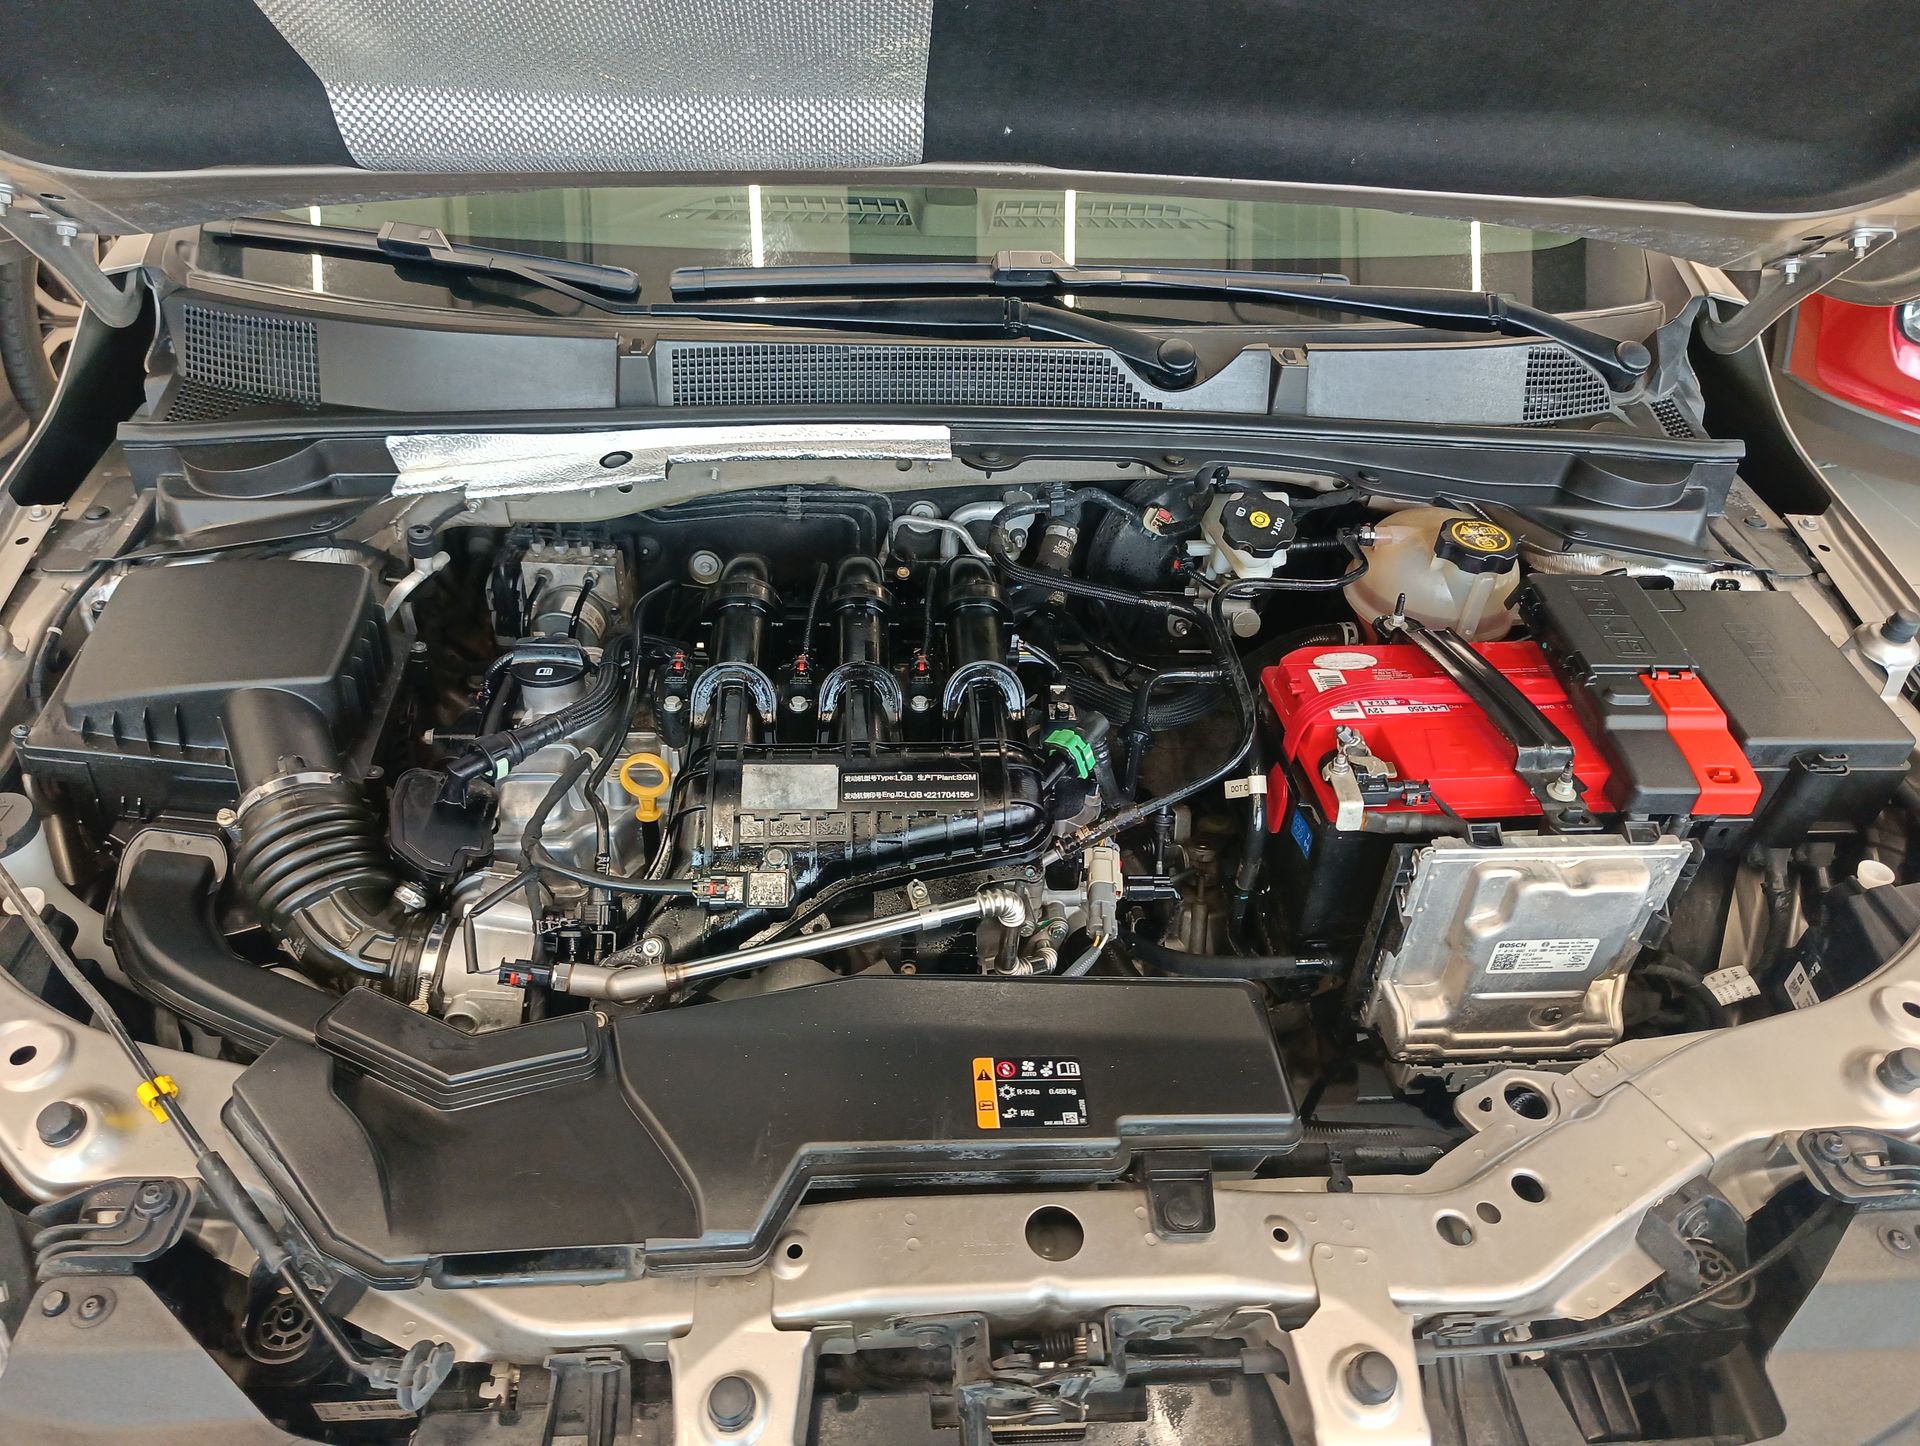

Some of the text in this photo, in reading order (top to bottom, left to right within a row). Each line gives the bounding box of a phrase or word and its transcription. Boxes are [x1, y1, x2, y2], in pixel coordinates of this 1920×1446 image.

[1273, 517, 1285, 532] DOT
[1230, 785, 1243, 793] DOT
[1067, 1088, 1077, 1096] kg
[1020, 1109, 1035, 1117] PAG
